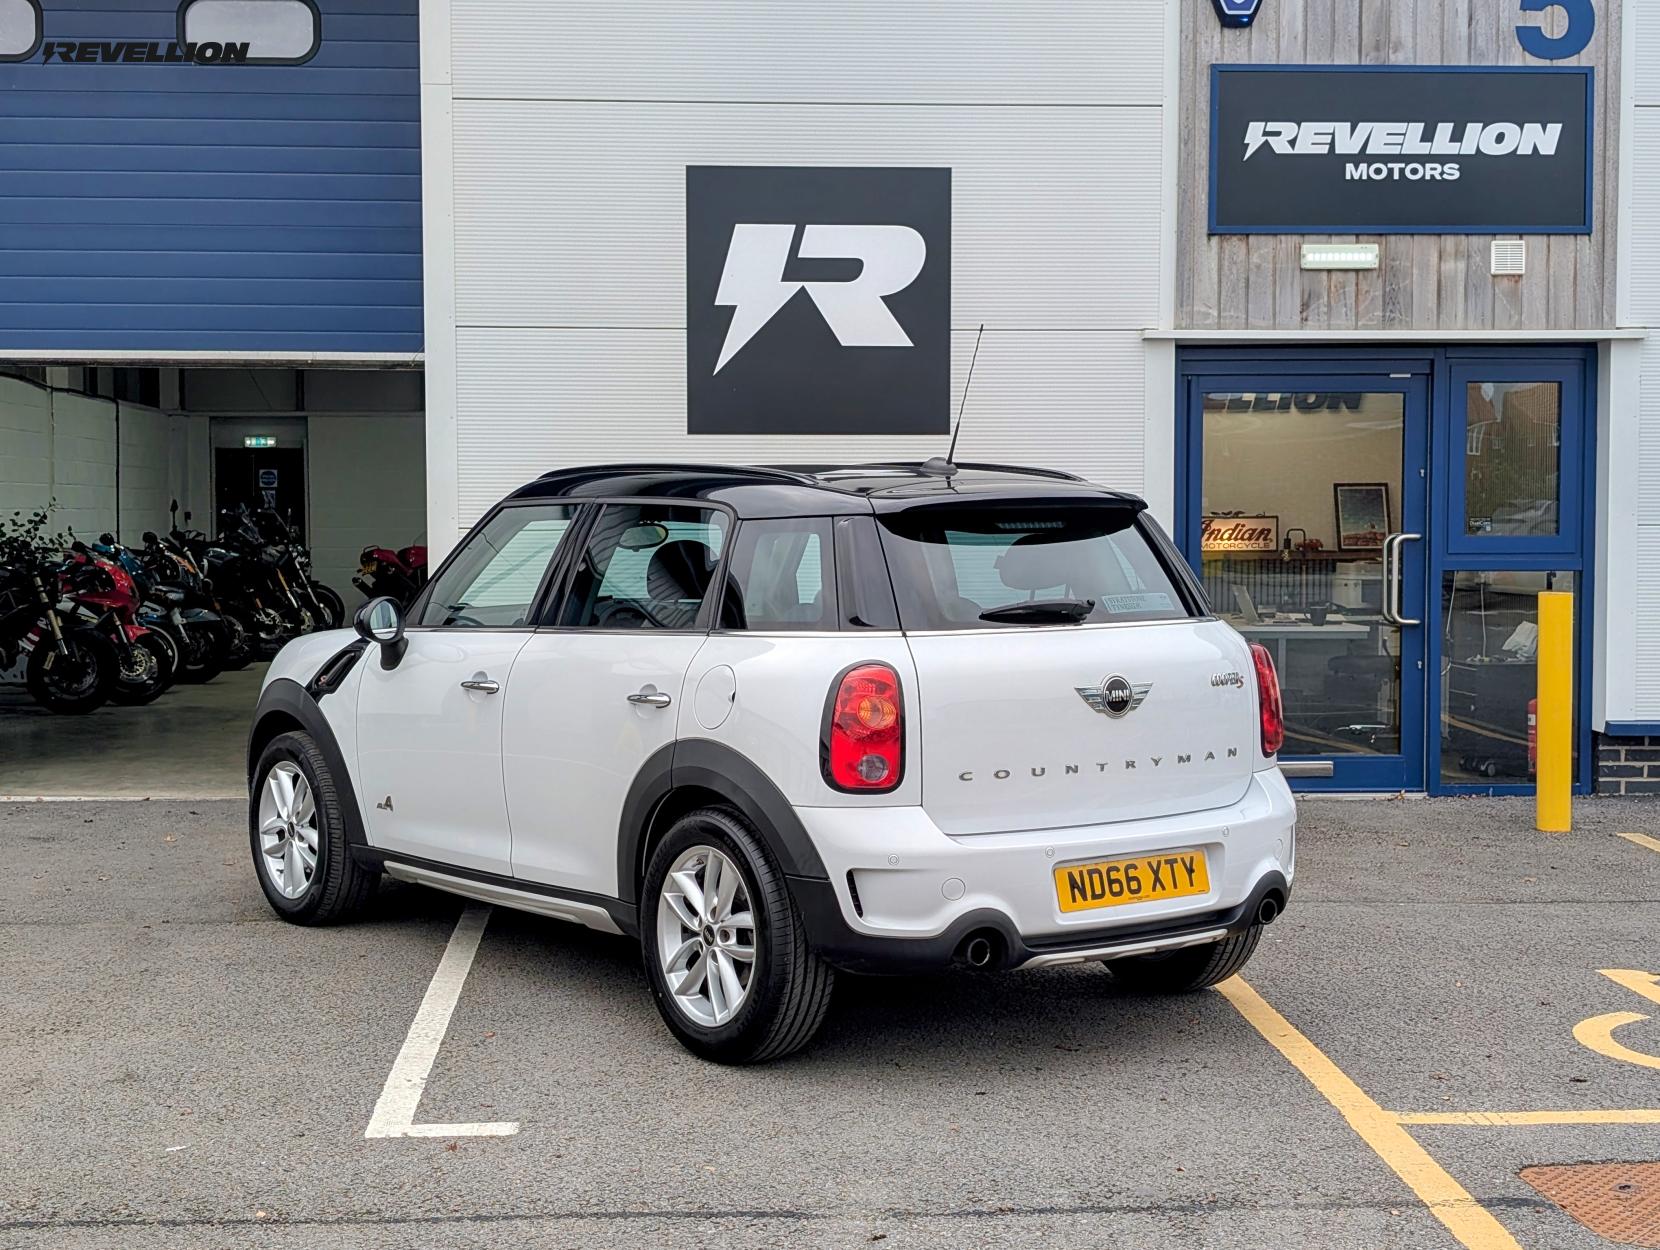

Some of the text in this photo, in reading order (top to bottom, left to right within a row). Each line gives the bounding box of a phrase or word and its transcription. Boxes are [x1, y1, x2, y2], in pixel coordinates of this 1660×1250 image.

[42, 41, 250, 66] REVELLION
[1243, 121, 1563, 161] REVELLION
[1345, 163, 1460, 180] MOTORS
[1201, 519, 1272, 542] Indian
[1106, 689, 1131, 703] MINI
[958, 747, 1238, 782] COUNTRYMAN
[1067, 856, 1195, 903] ND66 XTY
